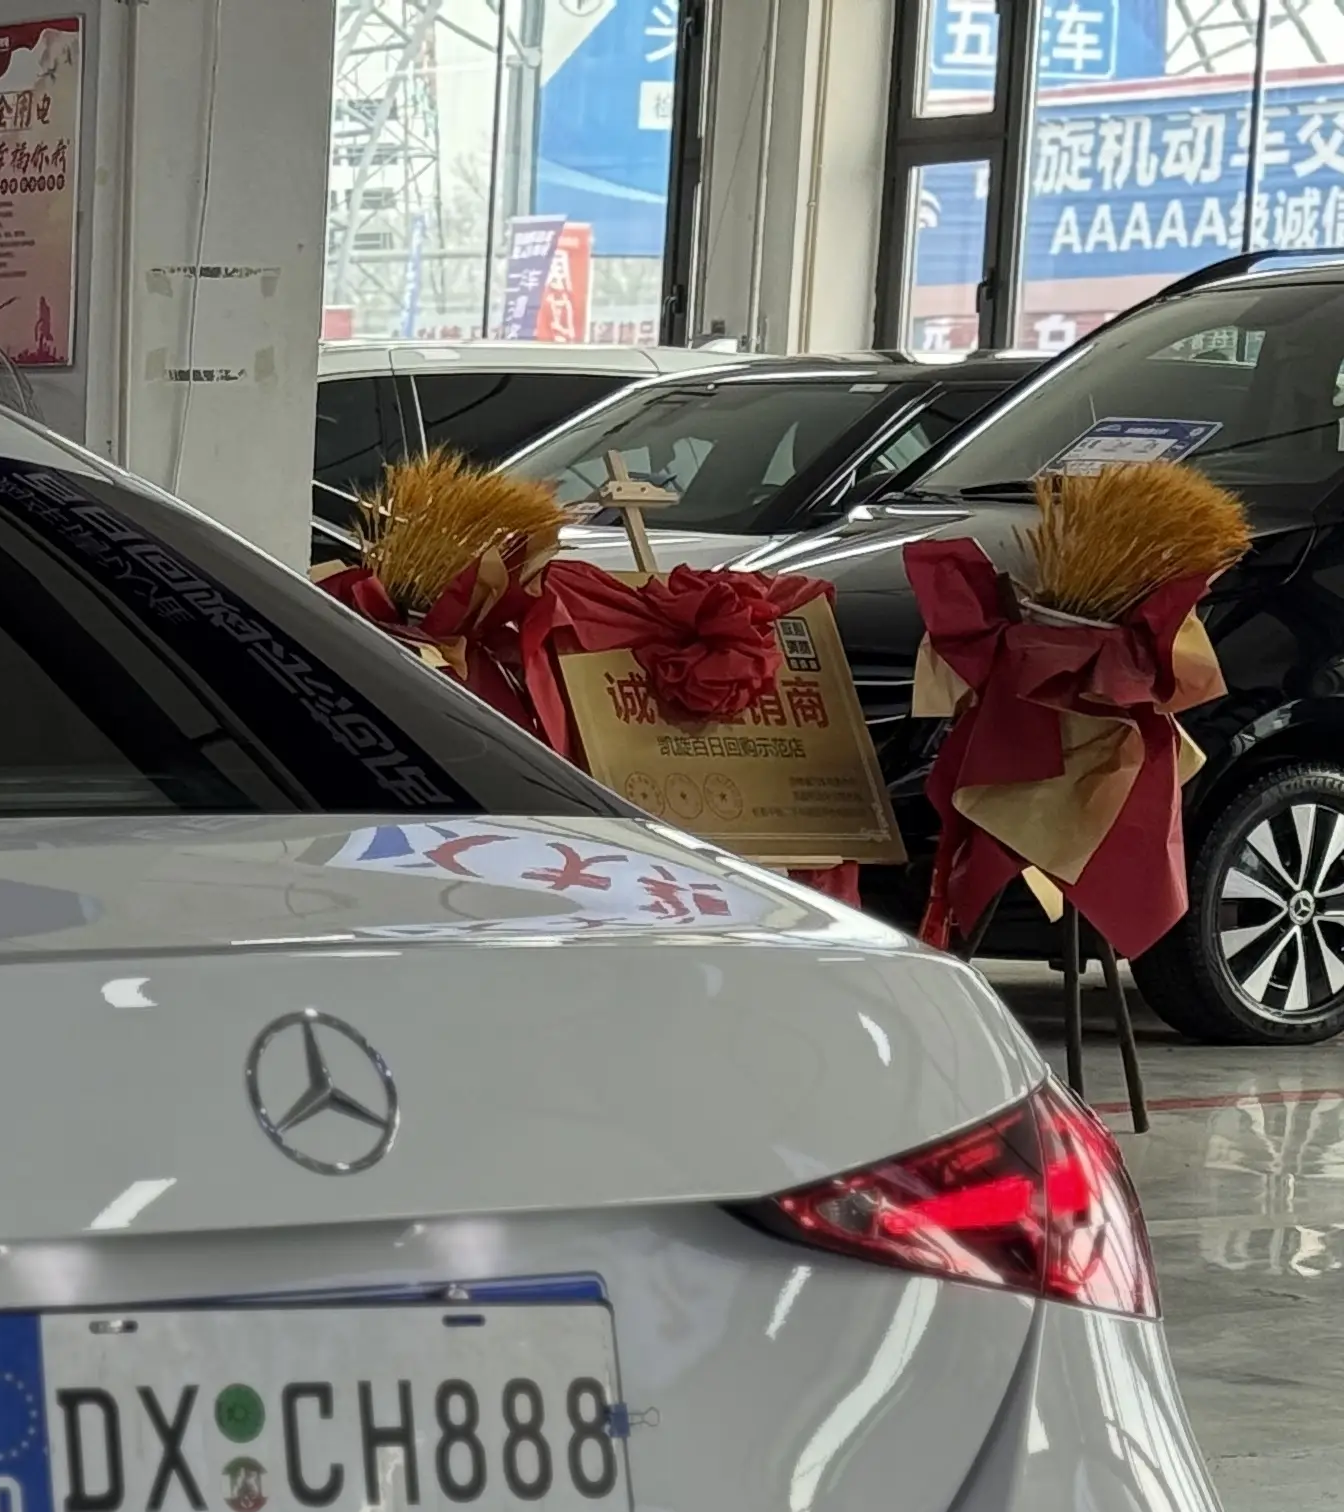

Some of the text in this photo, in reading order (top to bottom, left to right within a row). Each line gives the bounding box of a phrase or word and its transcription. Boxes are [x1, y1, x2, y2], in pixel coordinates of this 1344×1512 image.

[976, 98, 1344, 199] 旋机动车交
[604, 671, 830, 729] 诚销商
[657, 735, 807, 759] 凯旋百日回购示范店
[280, 1376, 618, 1508] CH888
